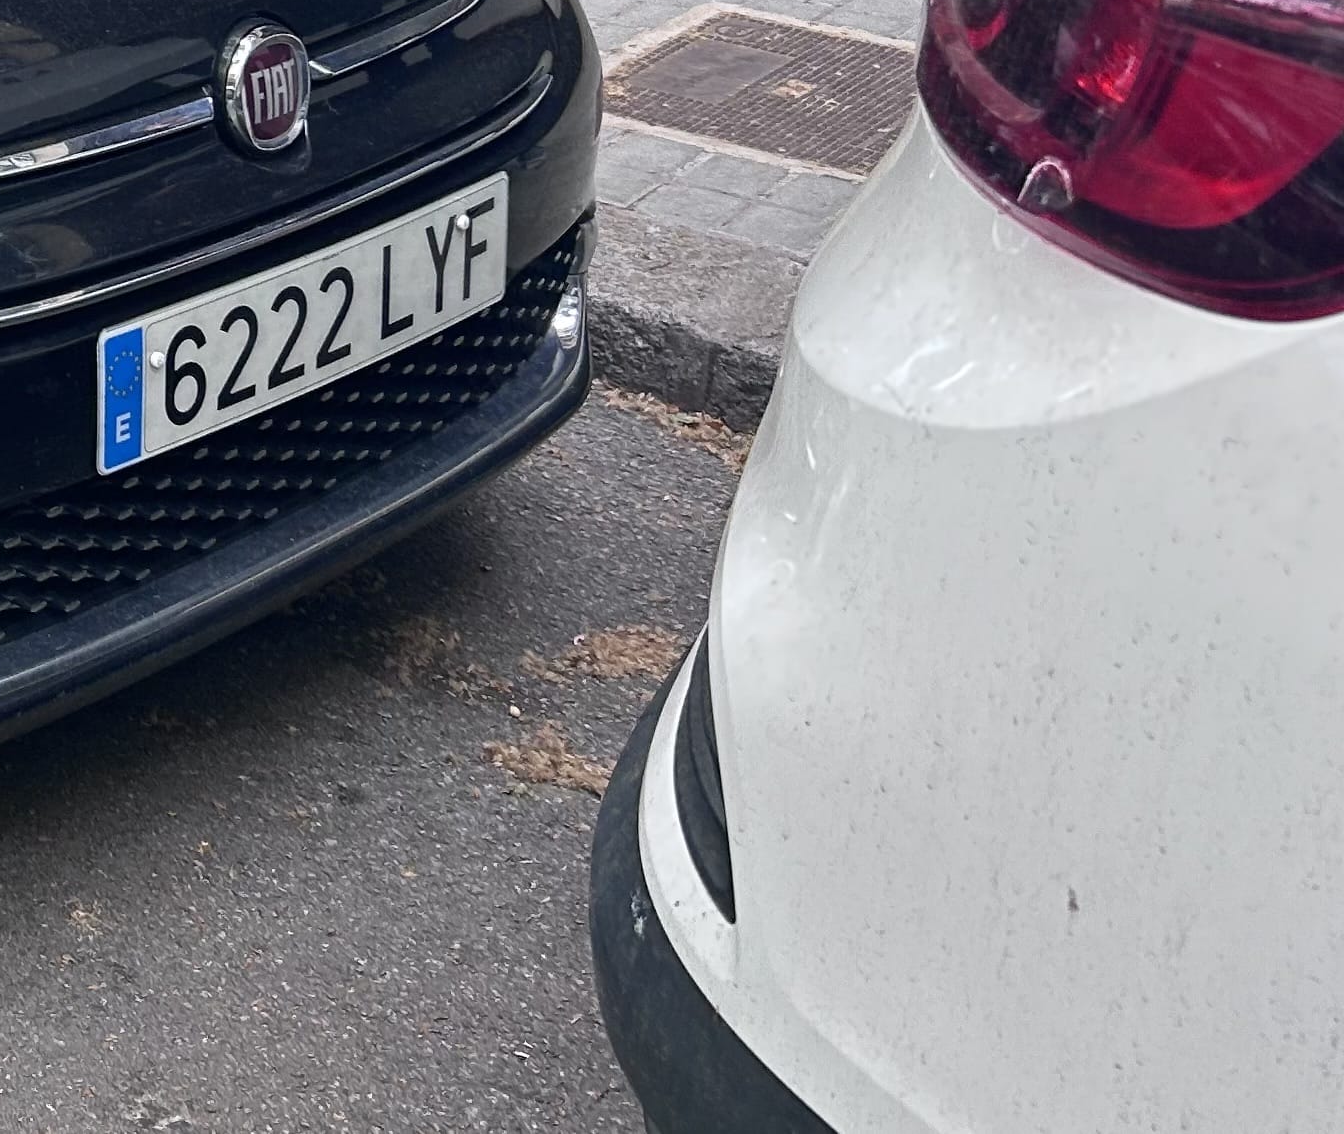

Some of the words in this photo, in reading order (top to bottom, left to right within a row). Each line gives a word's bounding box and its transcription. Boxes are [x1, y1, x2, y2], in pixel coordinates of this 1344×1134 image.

[250, 58, 297, 125] FIAT
[163, 266, 354, 427] 6222
[380, 198, 496, 342] LYF
[115, 412, 131, 443] E
